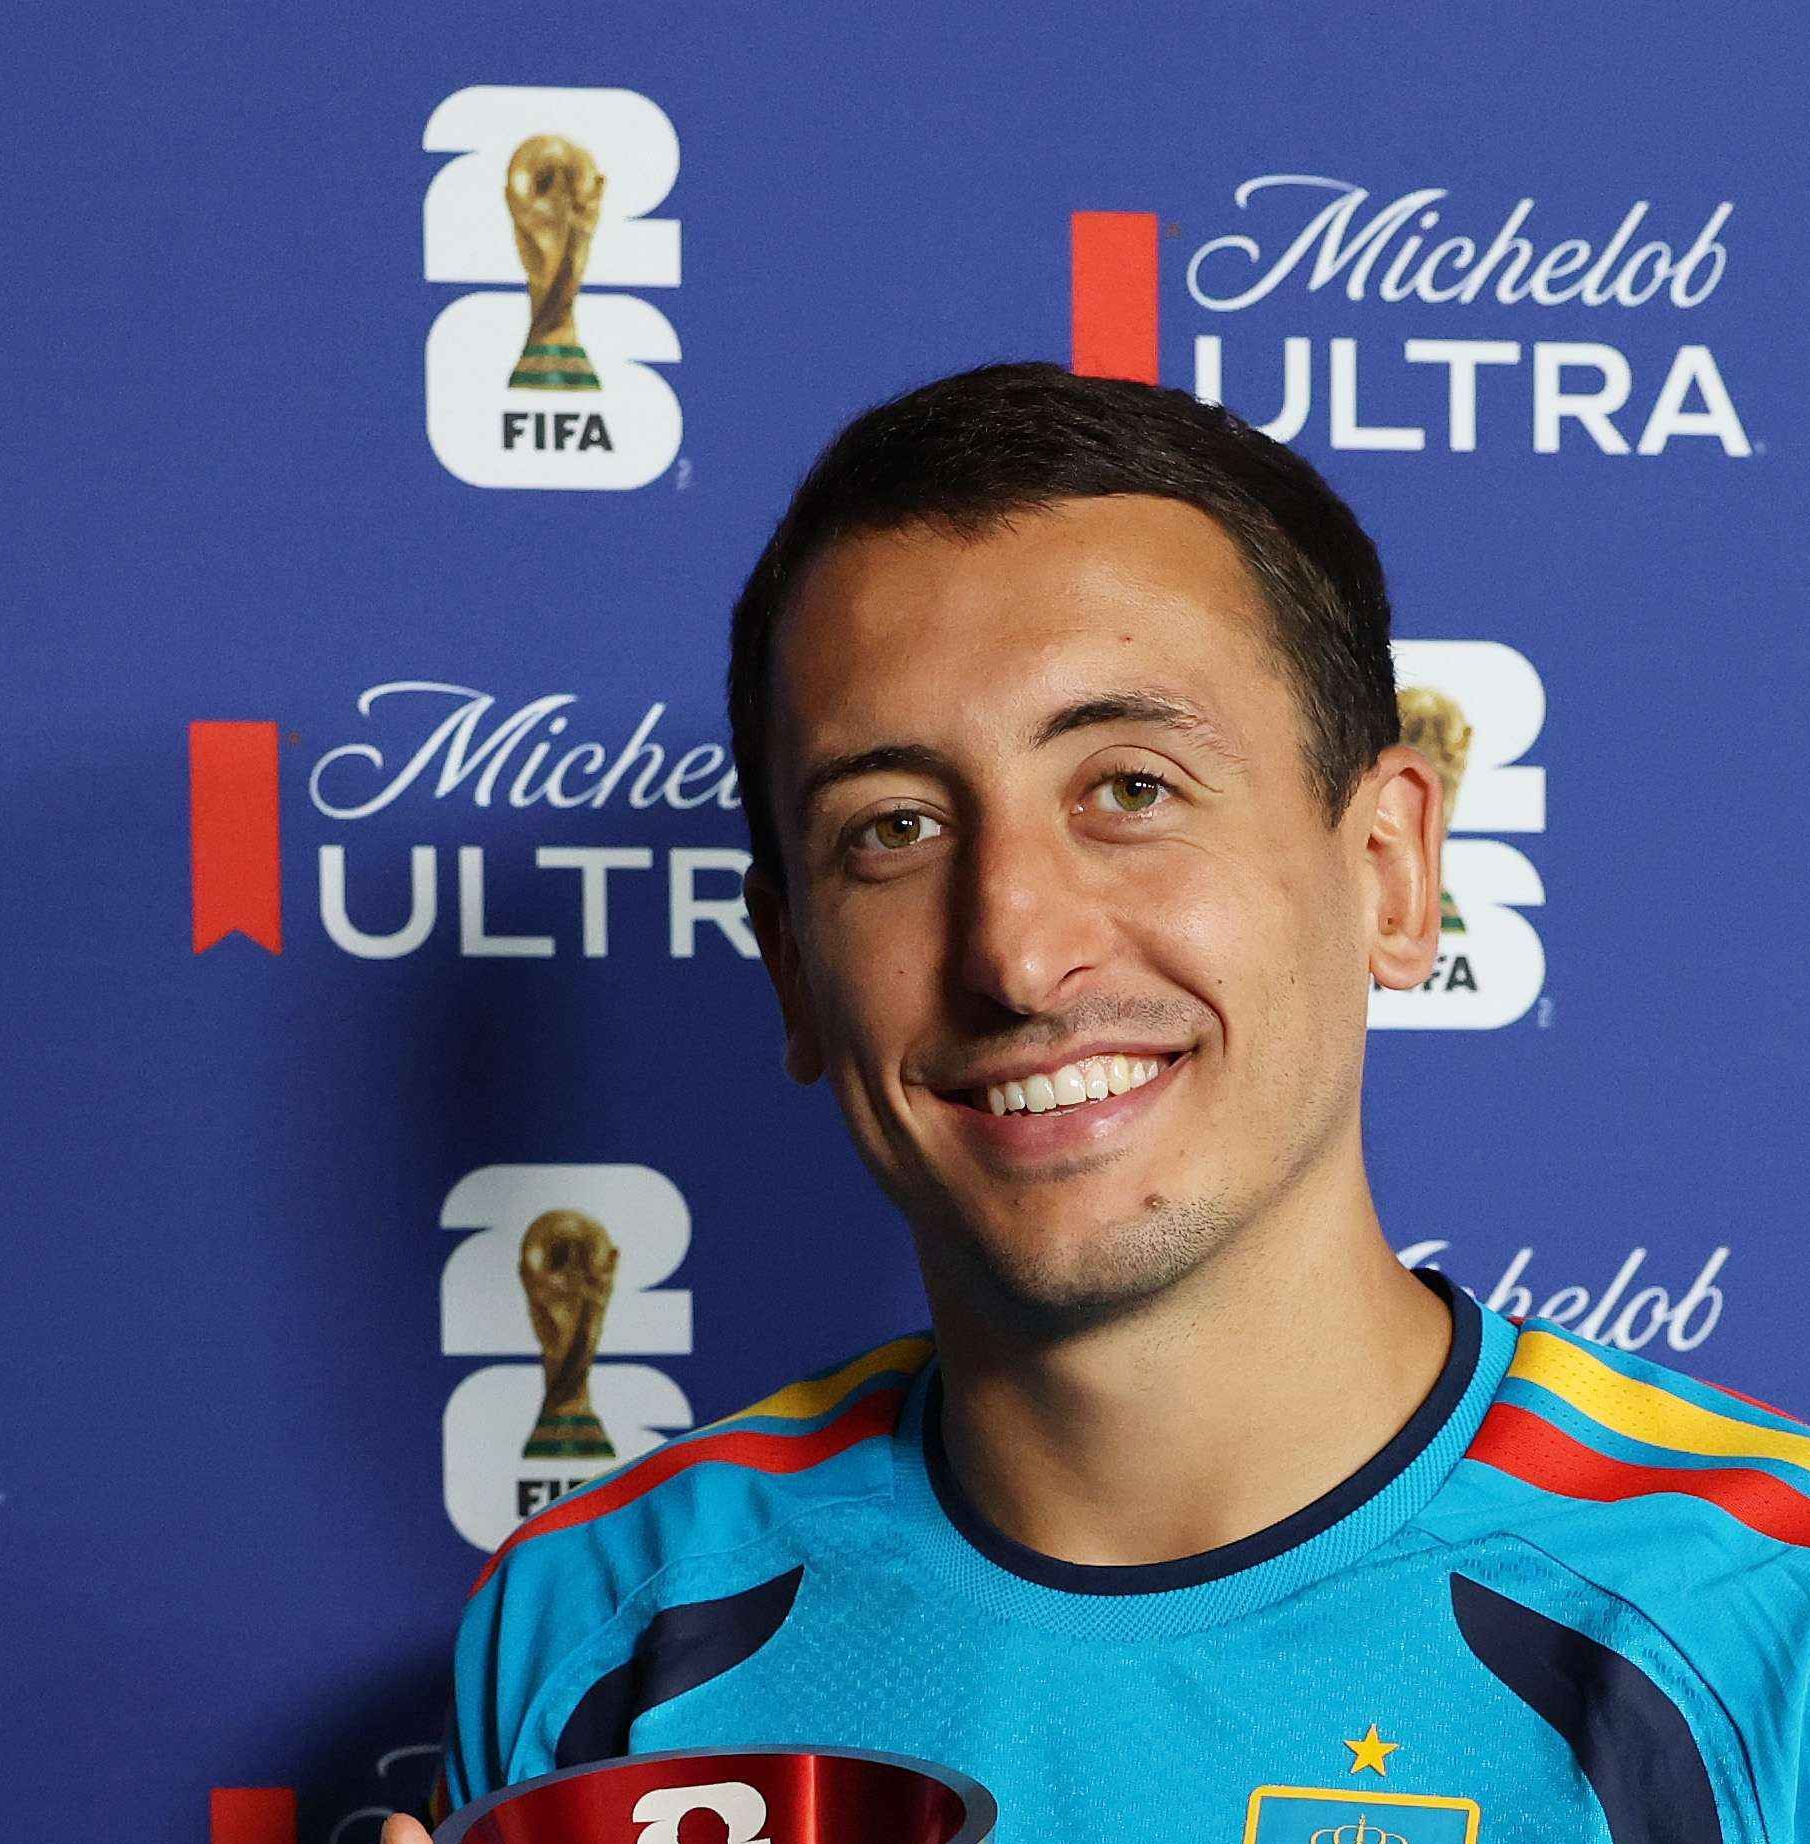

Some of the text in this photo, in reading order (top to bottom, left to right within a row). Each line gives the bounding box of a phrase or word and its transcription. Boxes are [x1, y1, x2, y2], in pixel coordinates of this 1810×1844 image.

[1187, 175, 1733, 311] Michelob
[501, 410, 615, 453] FIFA
[1195, 335, 1752, 457] ULTRA
[319, 845, 761, 959] ULTR
